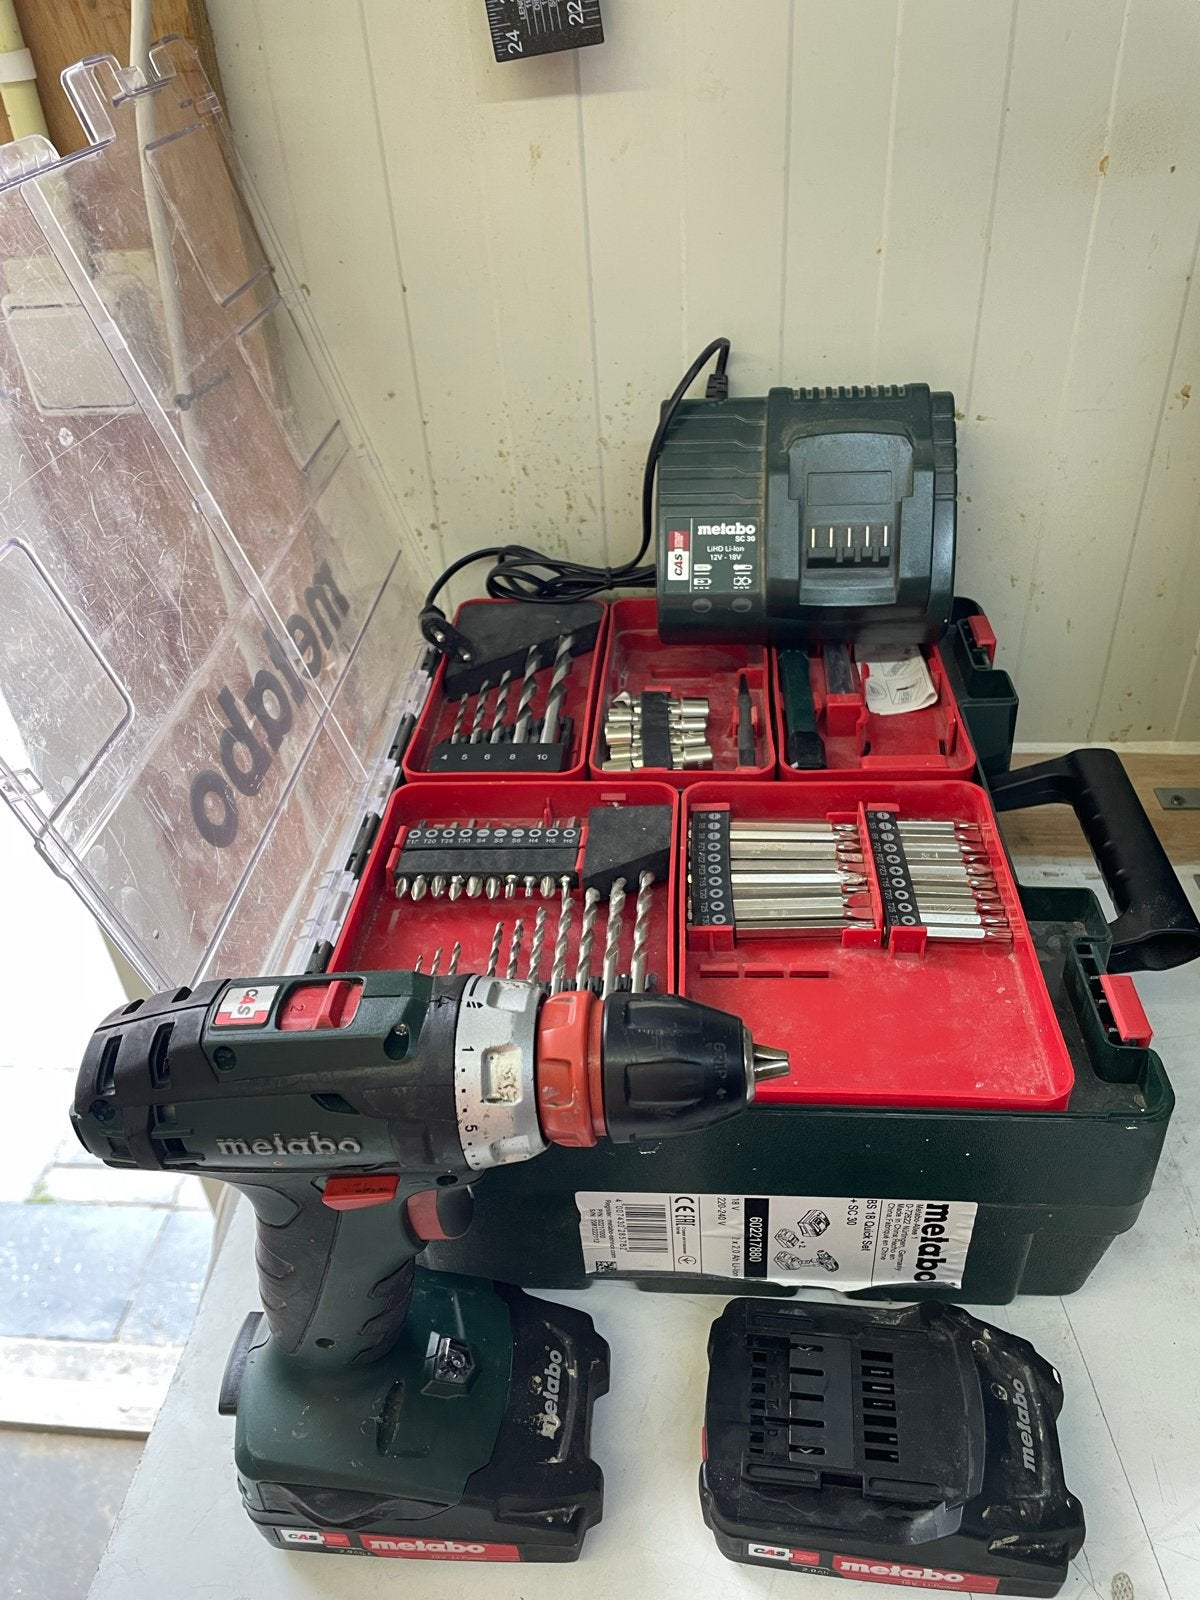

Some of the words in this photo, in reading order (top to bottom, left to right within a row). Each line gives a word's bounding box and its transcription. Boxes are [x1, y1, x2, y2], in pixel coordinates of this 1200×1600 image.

[566, 0, 584, 26] 22
[505, 29, 523, 54] 24
[697, 522, 756, 536] metabo
[674, 554, 683, 576] CAS
[873, 842, 881, 852] PZ1
[875, 853, 883, 864] PZ2
[878, 864, 887, 875] PZ3
[880, 877, 890, 887] T15
[884, 889, 893, 899] T20
[887, 902, 896, 913] T25
[237, 988, 259, 1016] CAS
[713, 1042, 728, 1080] GRIP
[465, 1124, 478, 1132] 5
[216, 1131, 361, 1156] metabo
[717, 1197, 727, 1221] 220-240
[847, 1204, 859, 1215] SC
[866, 1200, 878, 1209] BS
[894, 1203, 905, 1218] Made
[846, 1217, 857, 1226] 30
[865, 1211, 876, 1220] 18
[862, 1220, 875, 1239] Quick
[749, 1216, 763, 1263] 602217880
[861, 1240, 872, 1251] Set
[913, 1203, 949, 1281] metabo
[880, 1247, 890, 1261] Chine
[541, 1349, 563, 1439] etabo
[1012, 1378, 1036, 1473] metabo
[288, 1533, 318, 1541] CAS
[370, 1540, 487, 1554] metabo
[753, 1548, 786, 1557] CAS
[840, 1561, 965, 1583] metabo
